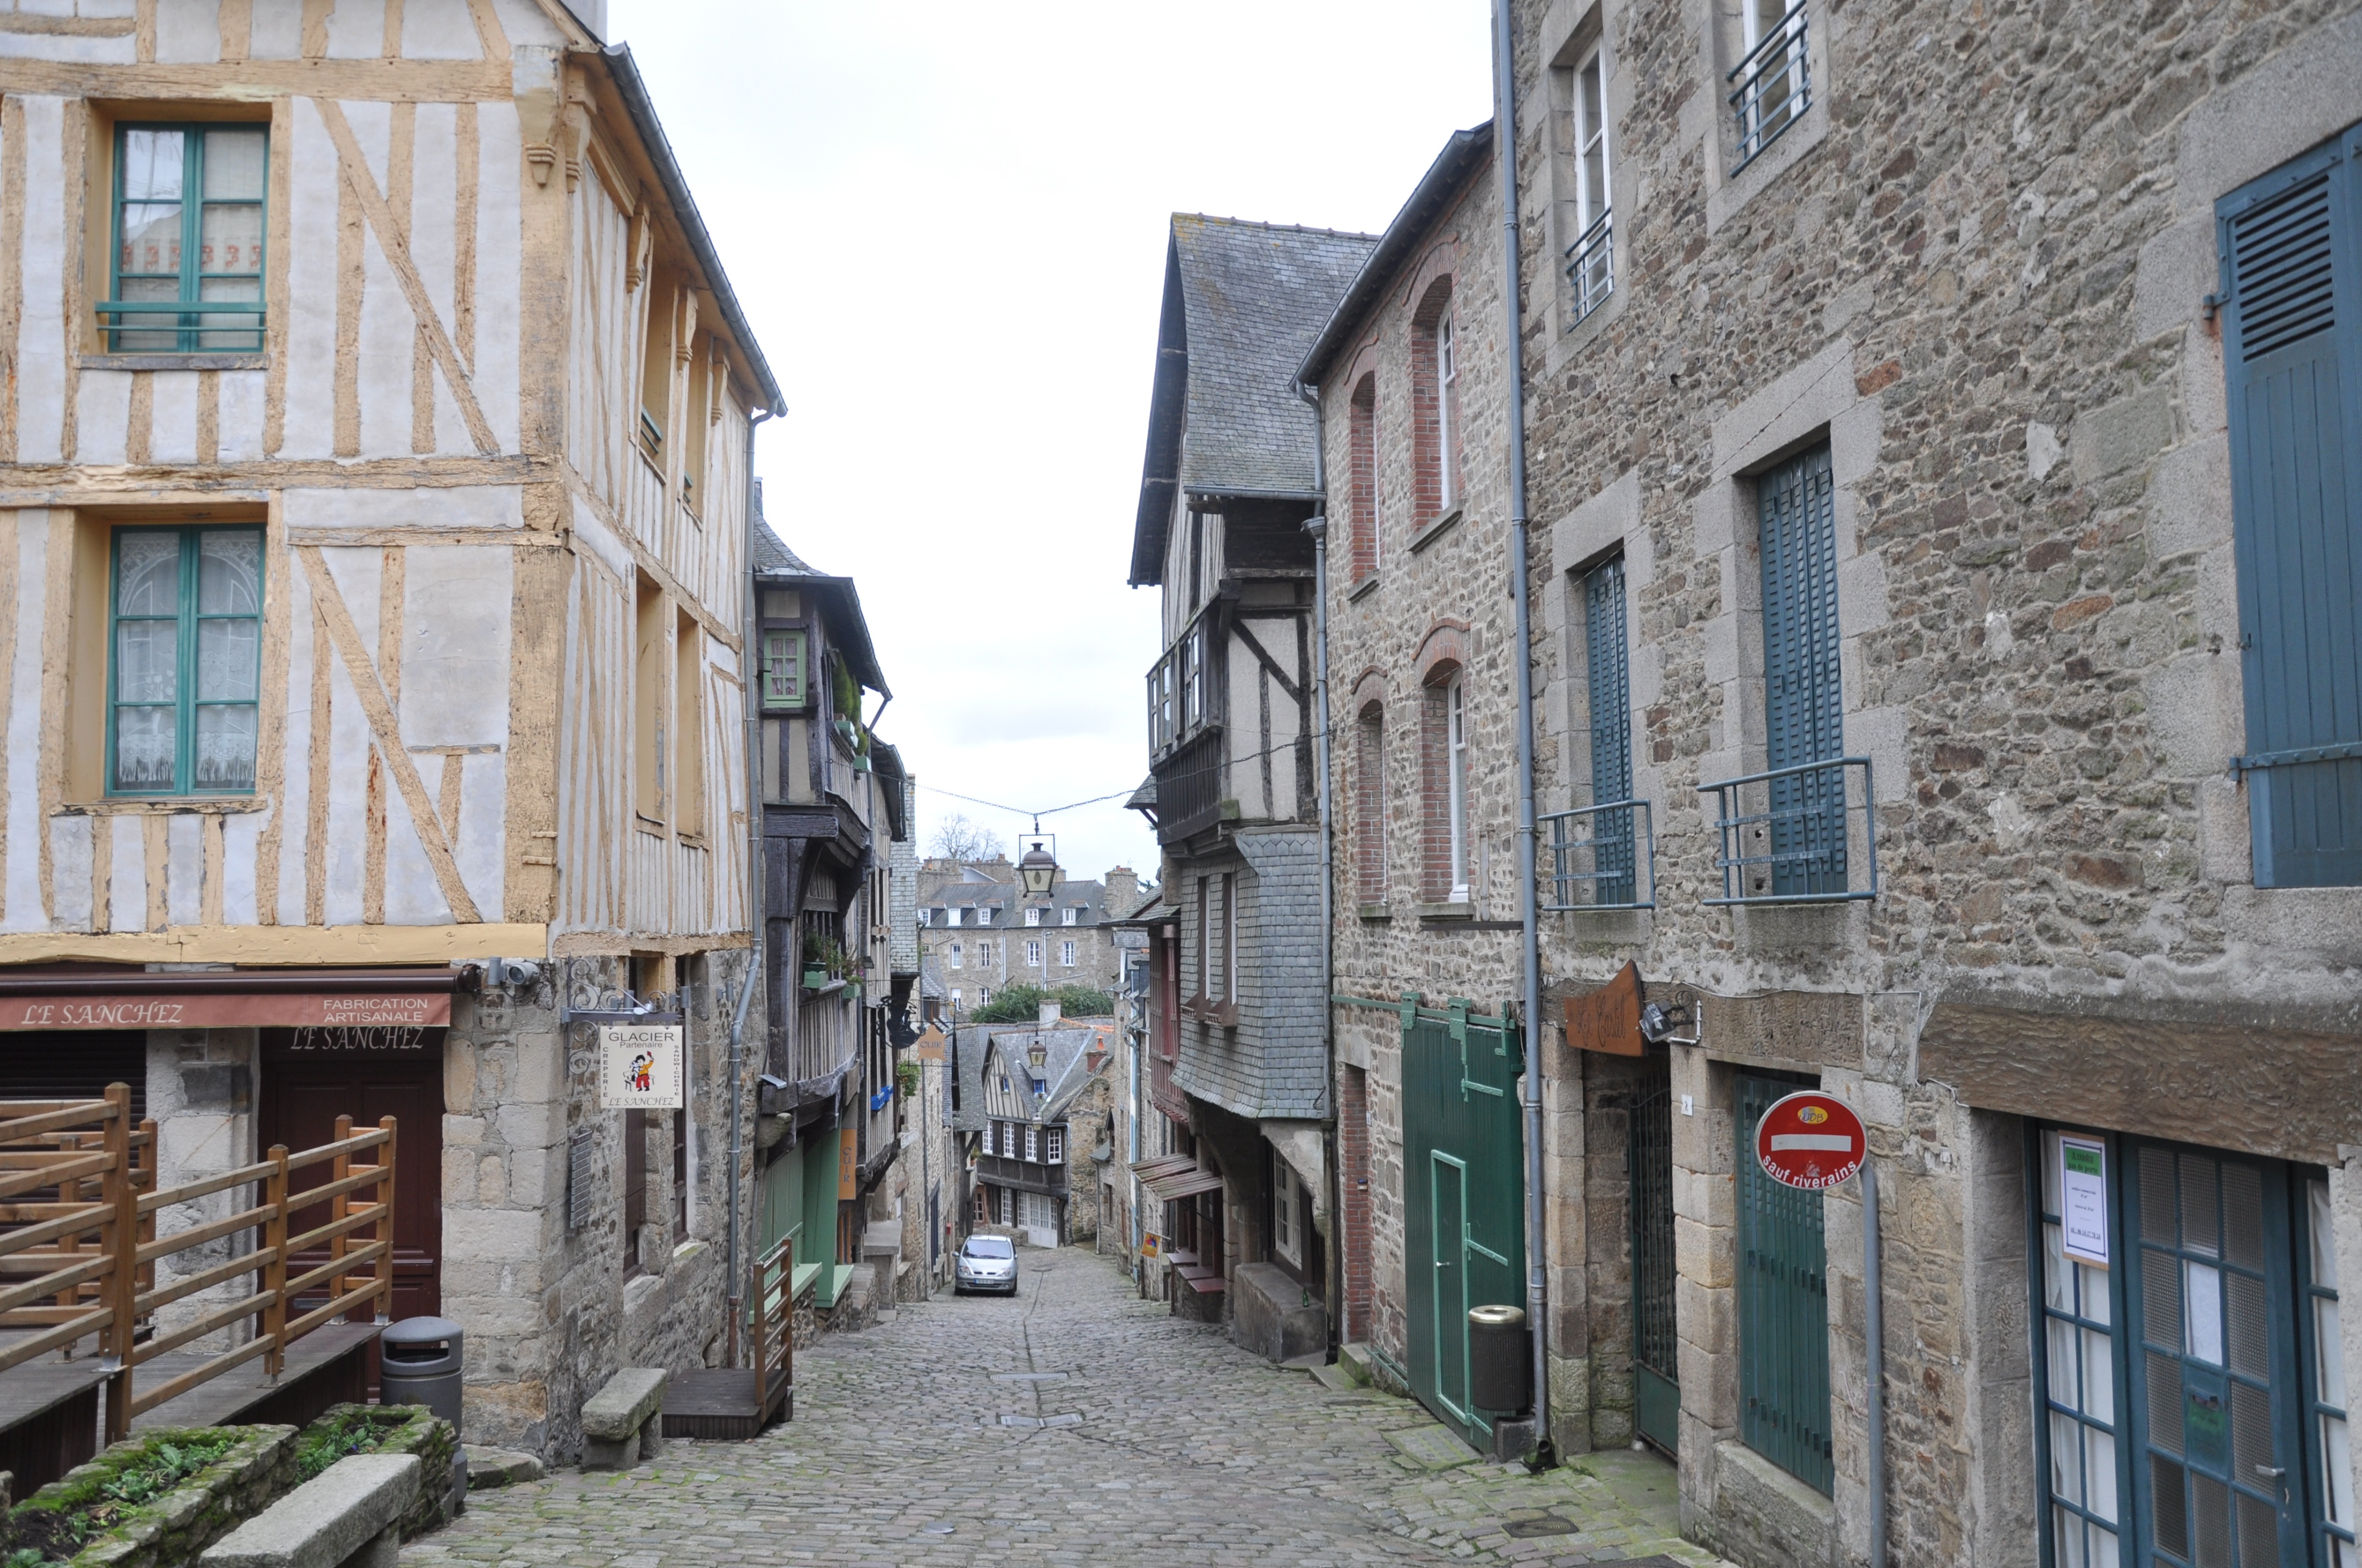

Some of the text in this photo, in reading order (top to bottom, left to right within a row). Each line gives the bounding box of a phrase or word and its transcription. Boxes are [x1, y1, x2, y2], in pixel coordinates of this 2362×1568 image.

[323, 999, 428, 1010] FABRICATION
[21, 1002, 183, 1024] LE SANCHEZ
[324, 1011, 423, 1022] ARTISANALE
[291, 1026, 424, 1050] LE SANCHEZ
[608, 1032, 674, 1041] GLACIER
[608, 1097, 674, 1106] LE SANCHEZ
[842, 1147, 852, 1183] CUIR
[1763, 1155, 1857, 1188] sauf riverains
